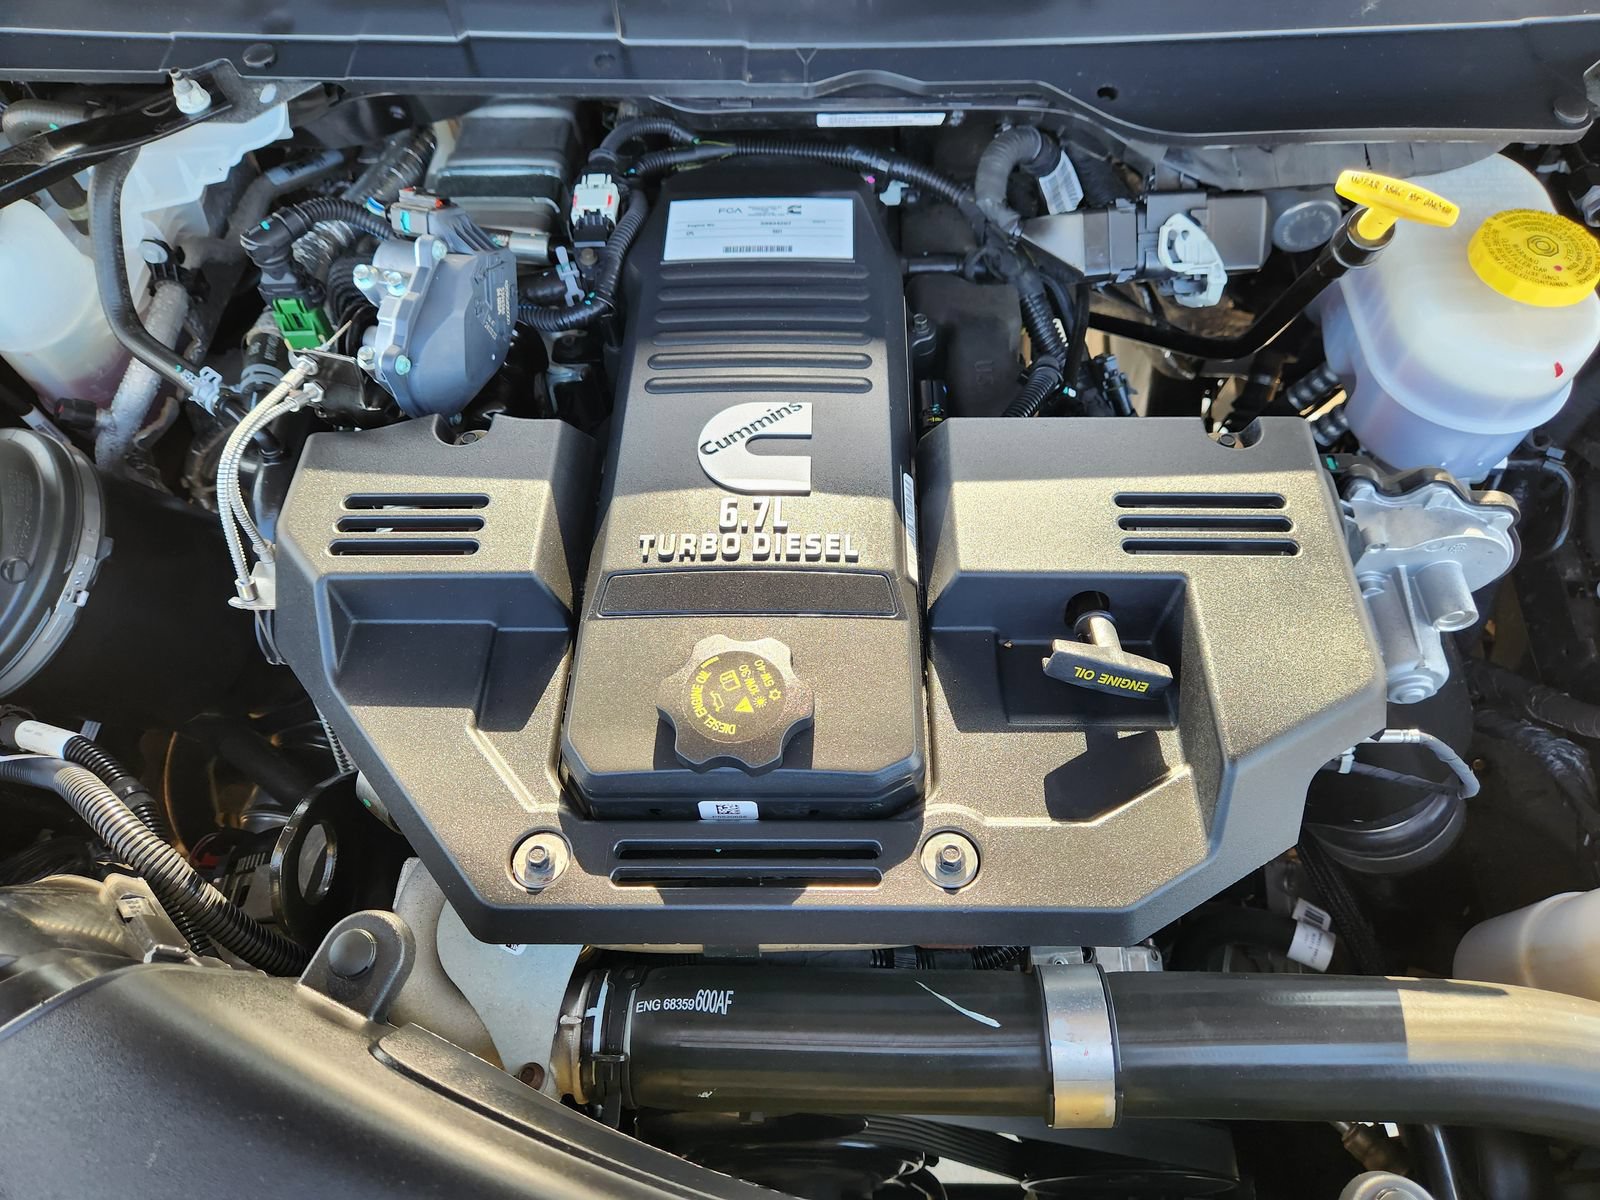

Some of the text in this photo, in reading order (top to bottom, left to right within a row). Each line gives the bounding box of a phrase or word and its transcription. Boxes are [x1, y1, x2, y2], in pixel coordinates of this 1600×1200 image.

[699, 401, 803, 456] Cummins
[719, 497, 789, 533] 6.7L
[640, 532, 859, 563] TURBO DIESEL
[754, 659, 775, 688] 5W-40
[1074, 666, 1150, 693] ENGINE OIL
[690, 684, 708, 719] ENGINE
[704, 715, 736, 735] DIESEL
[635, 999, 661, 1013] ENG
